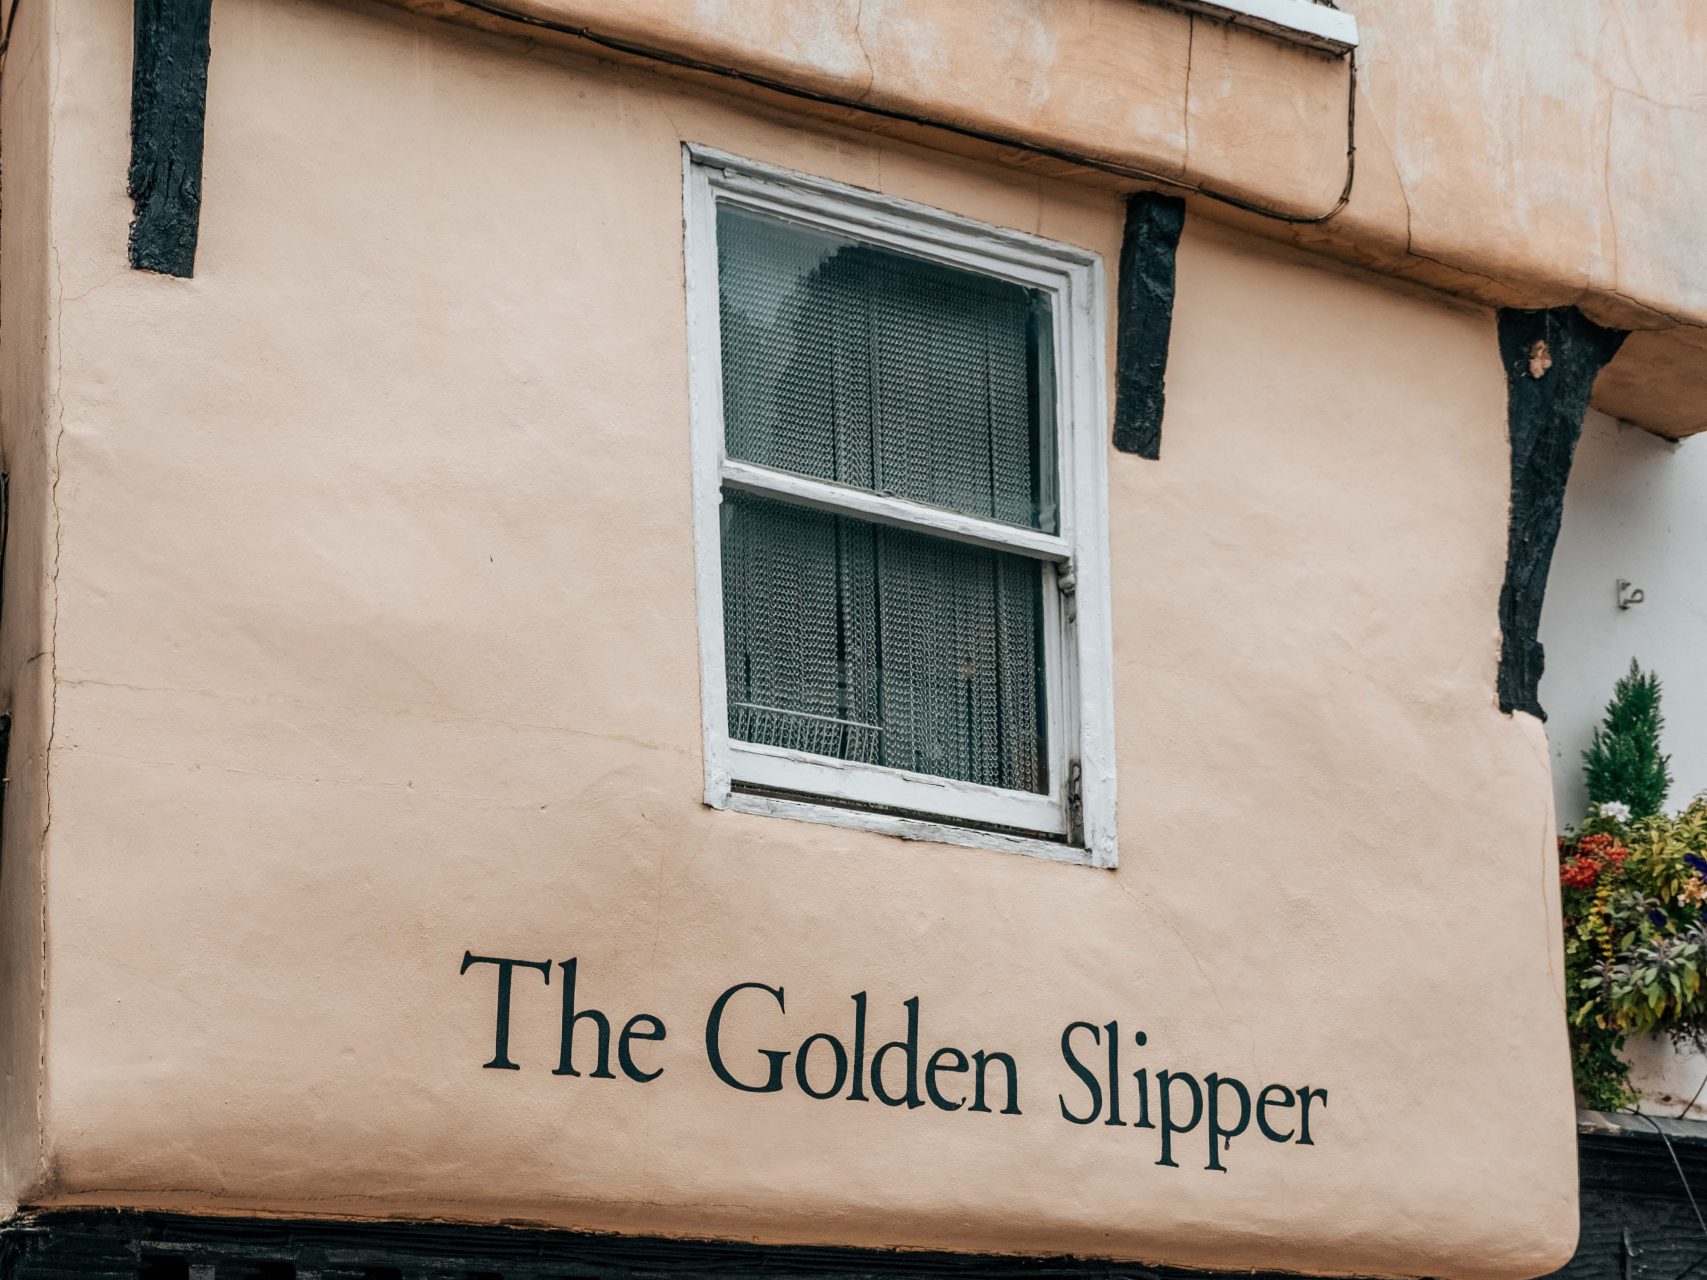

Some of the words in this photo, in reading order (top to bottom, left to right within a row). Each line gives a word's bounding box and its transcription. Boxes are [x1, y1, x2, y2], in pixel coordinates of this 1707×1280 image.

[459, 950, 668, 1082] The
[705, 982, 1022, 1116] Golden
[1058, 1019, 1329, 1174] Slipper
